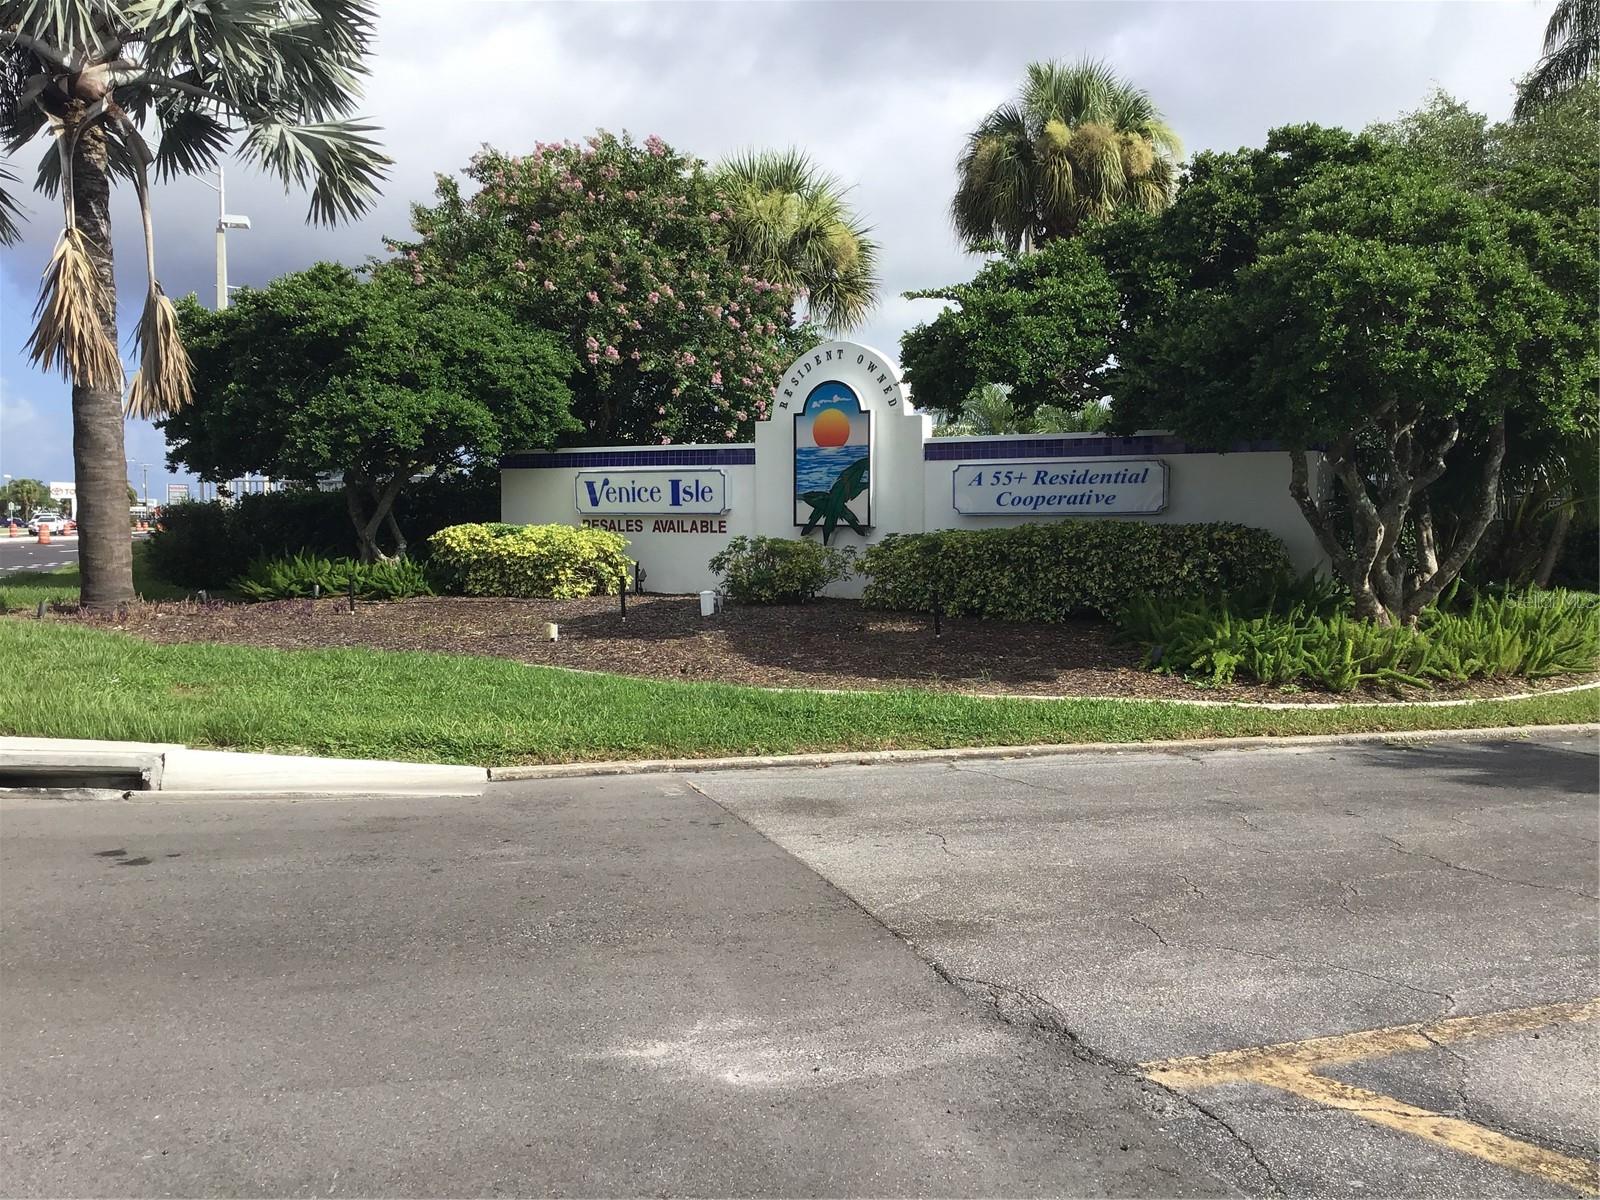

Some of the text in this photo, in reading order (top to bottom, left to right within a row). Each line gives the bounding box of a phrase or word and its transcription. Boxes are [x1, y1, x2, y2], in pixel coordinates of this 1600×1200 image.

[780, 349, 897, 410] RESIDENT OWNED
[968, 467, 1150, 486] A 55+ Residential
[584, 477, 713, 507] Venice Isle
[996, 489, 1117, 510] Cooperative
[652, 519, 727, 534] AVAILABLE
